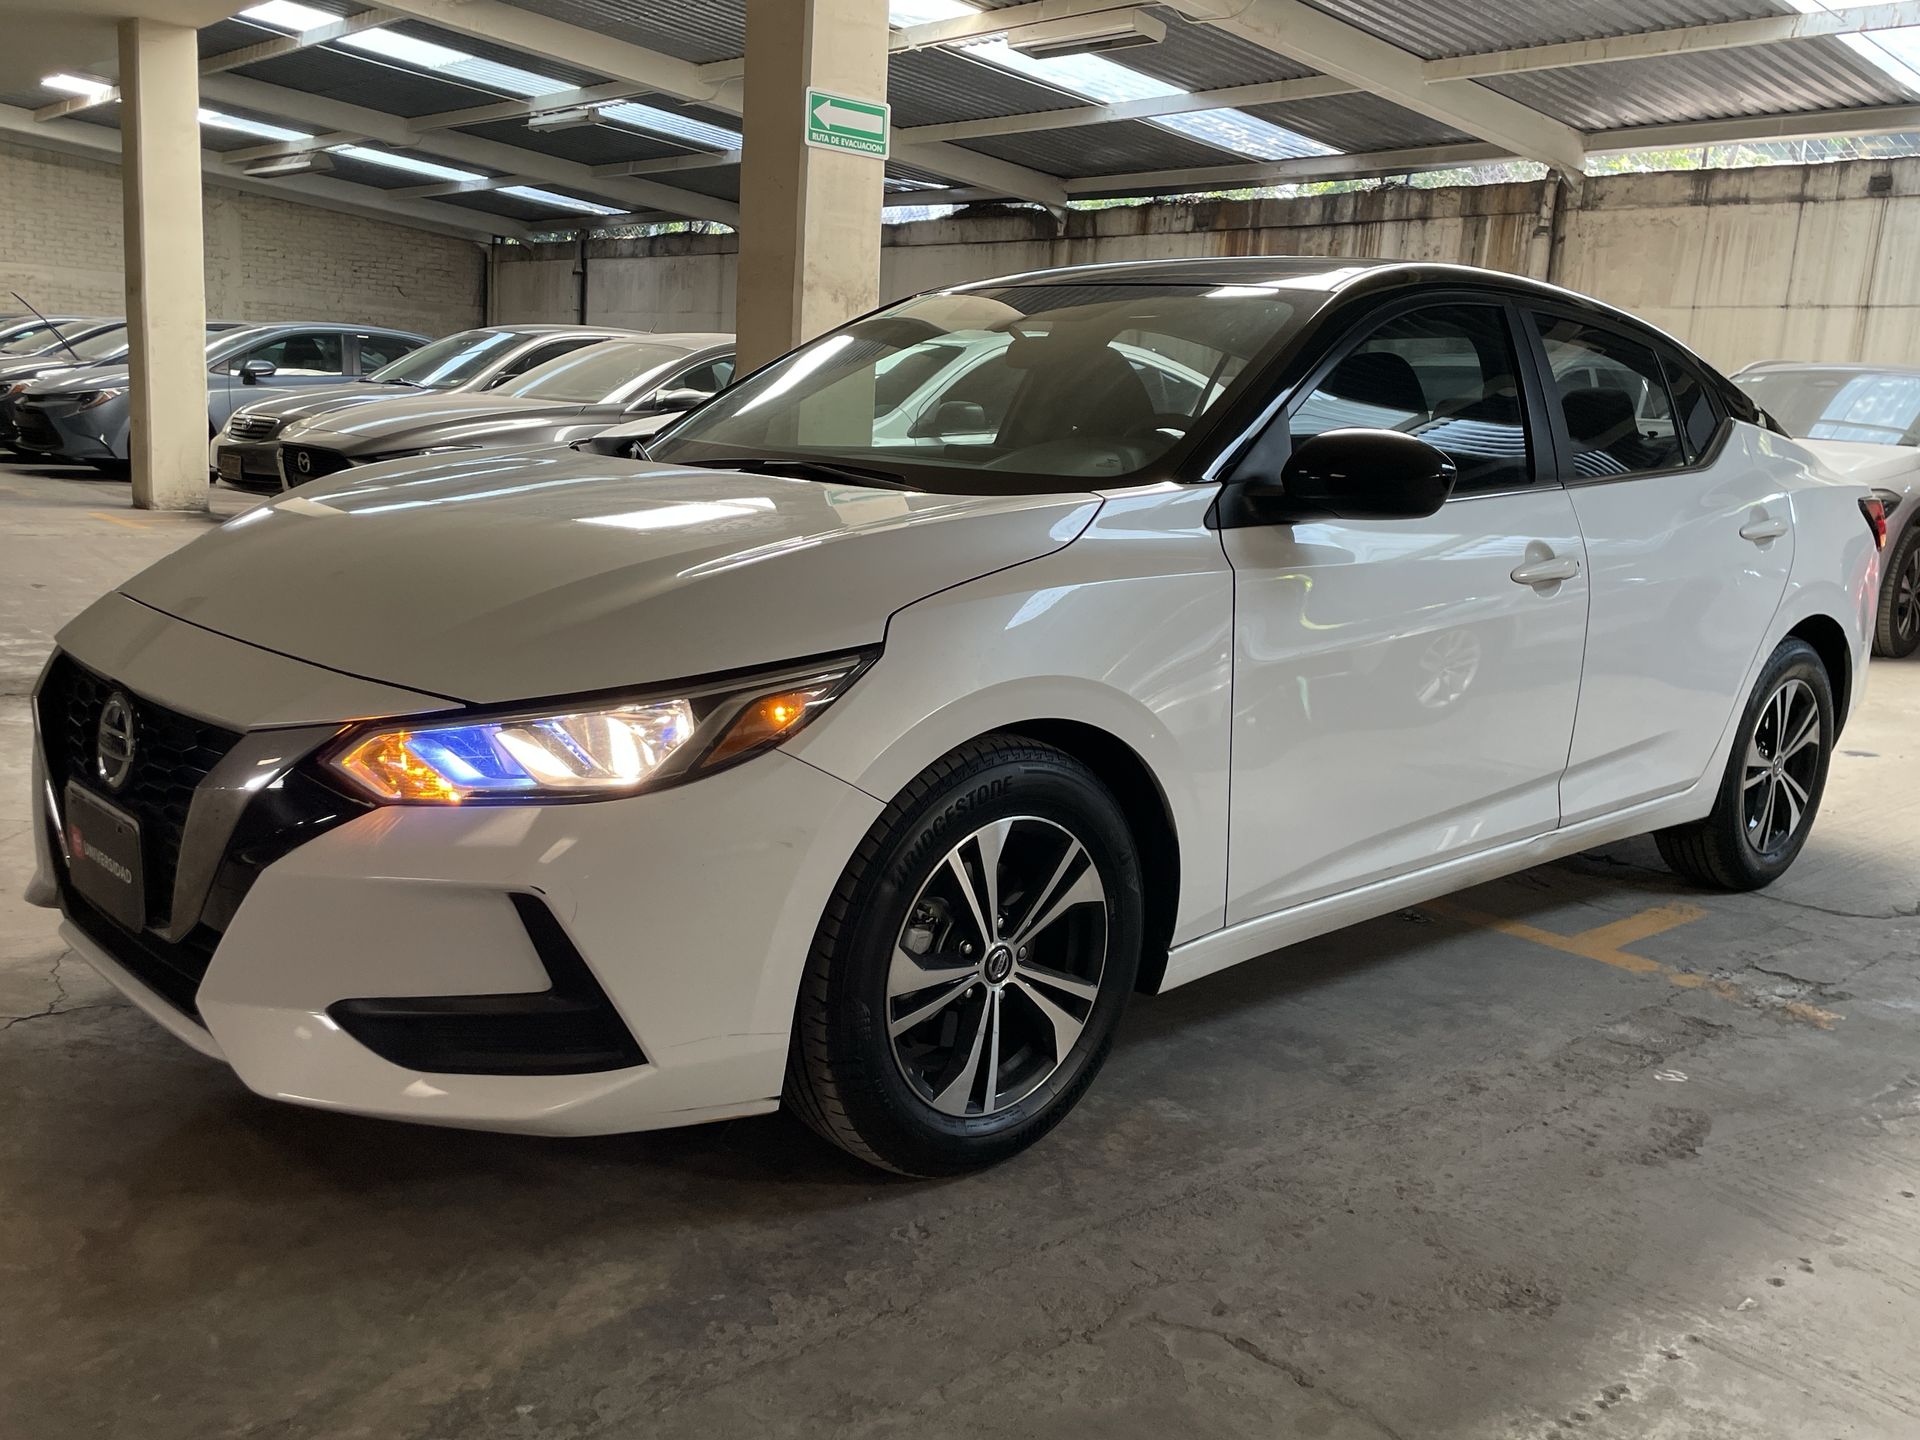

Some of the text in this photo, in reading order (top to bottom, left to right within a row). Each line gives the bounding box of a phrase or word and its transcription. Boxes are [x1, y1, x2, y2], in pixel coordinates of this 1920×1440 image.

[812, 132, 883, 153] RUTA DE EVACUACION
[83, 840, 132, 885] UNIVERSIDAD
